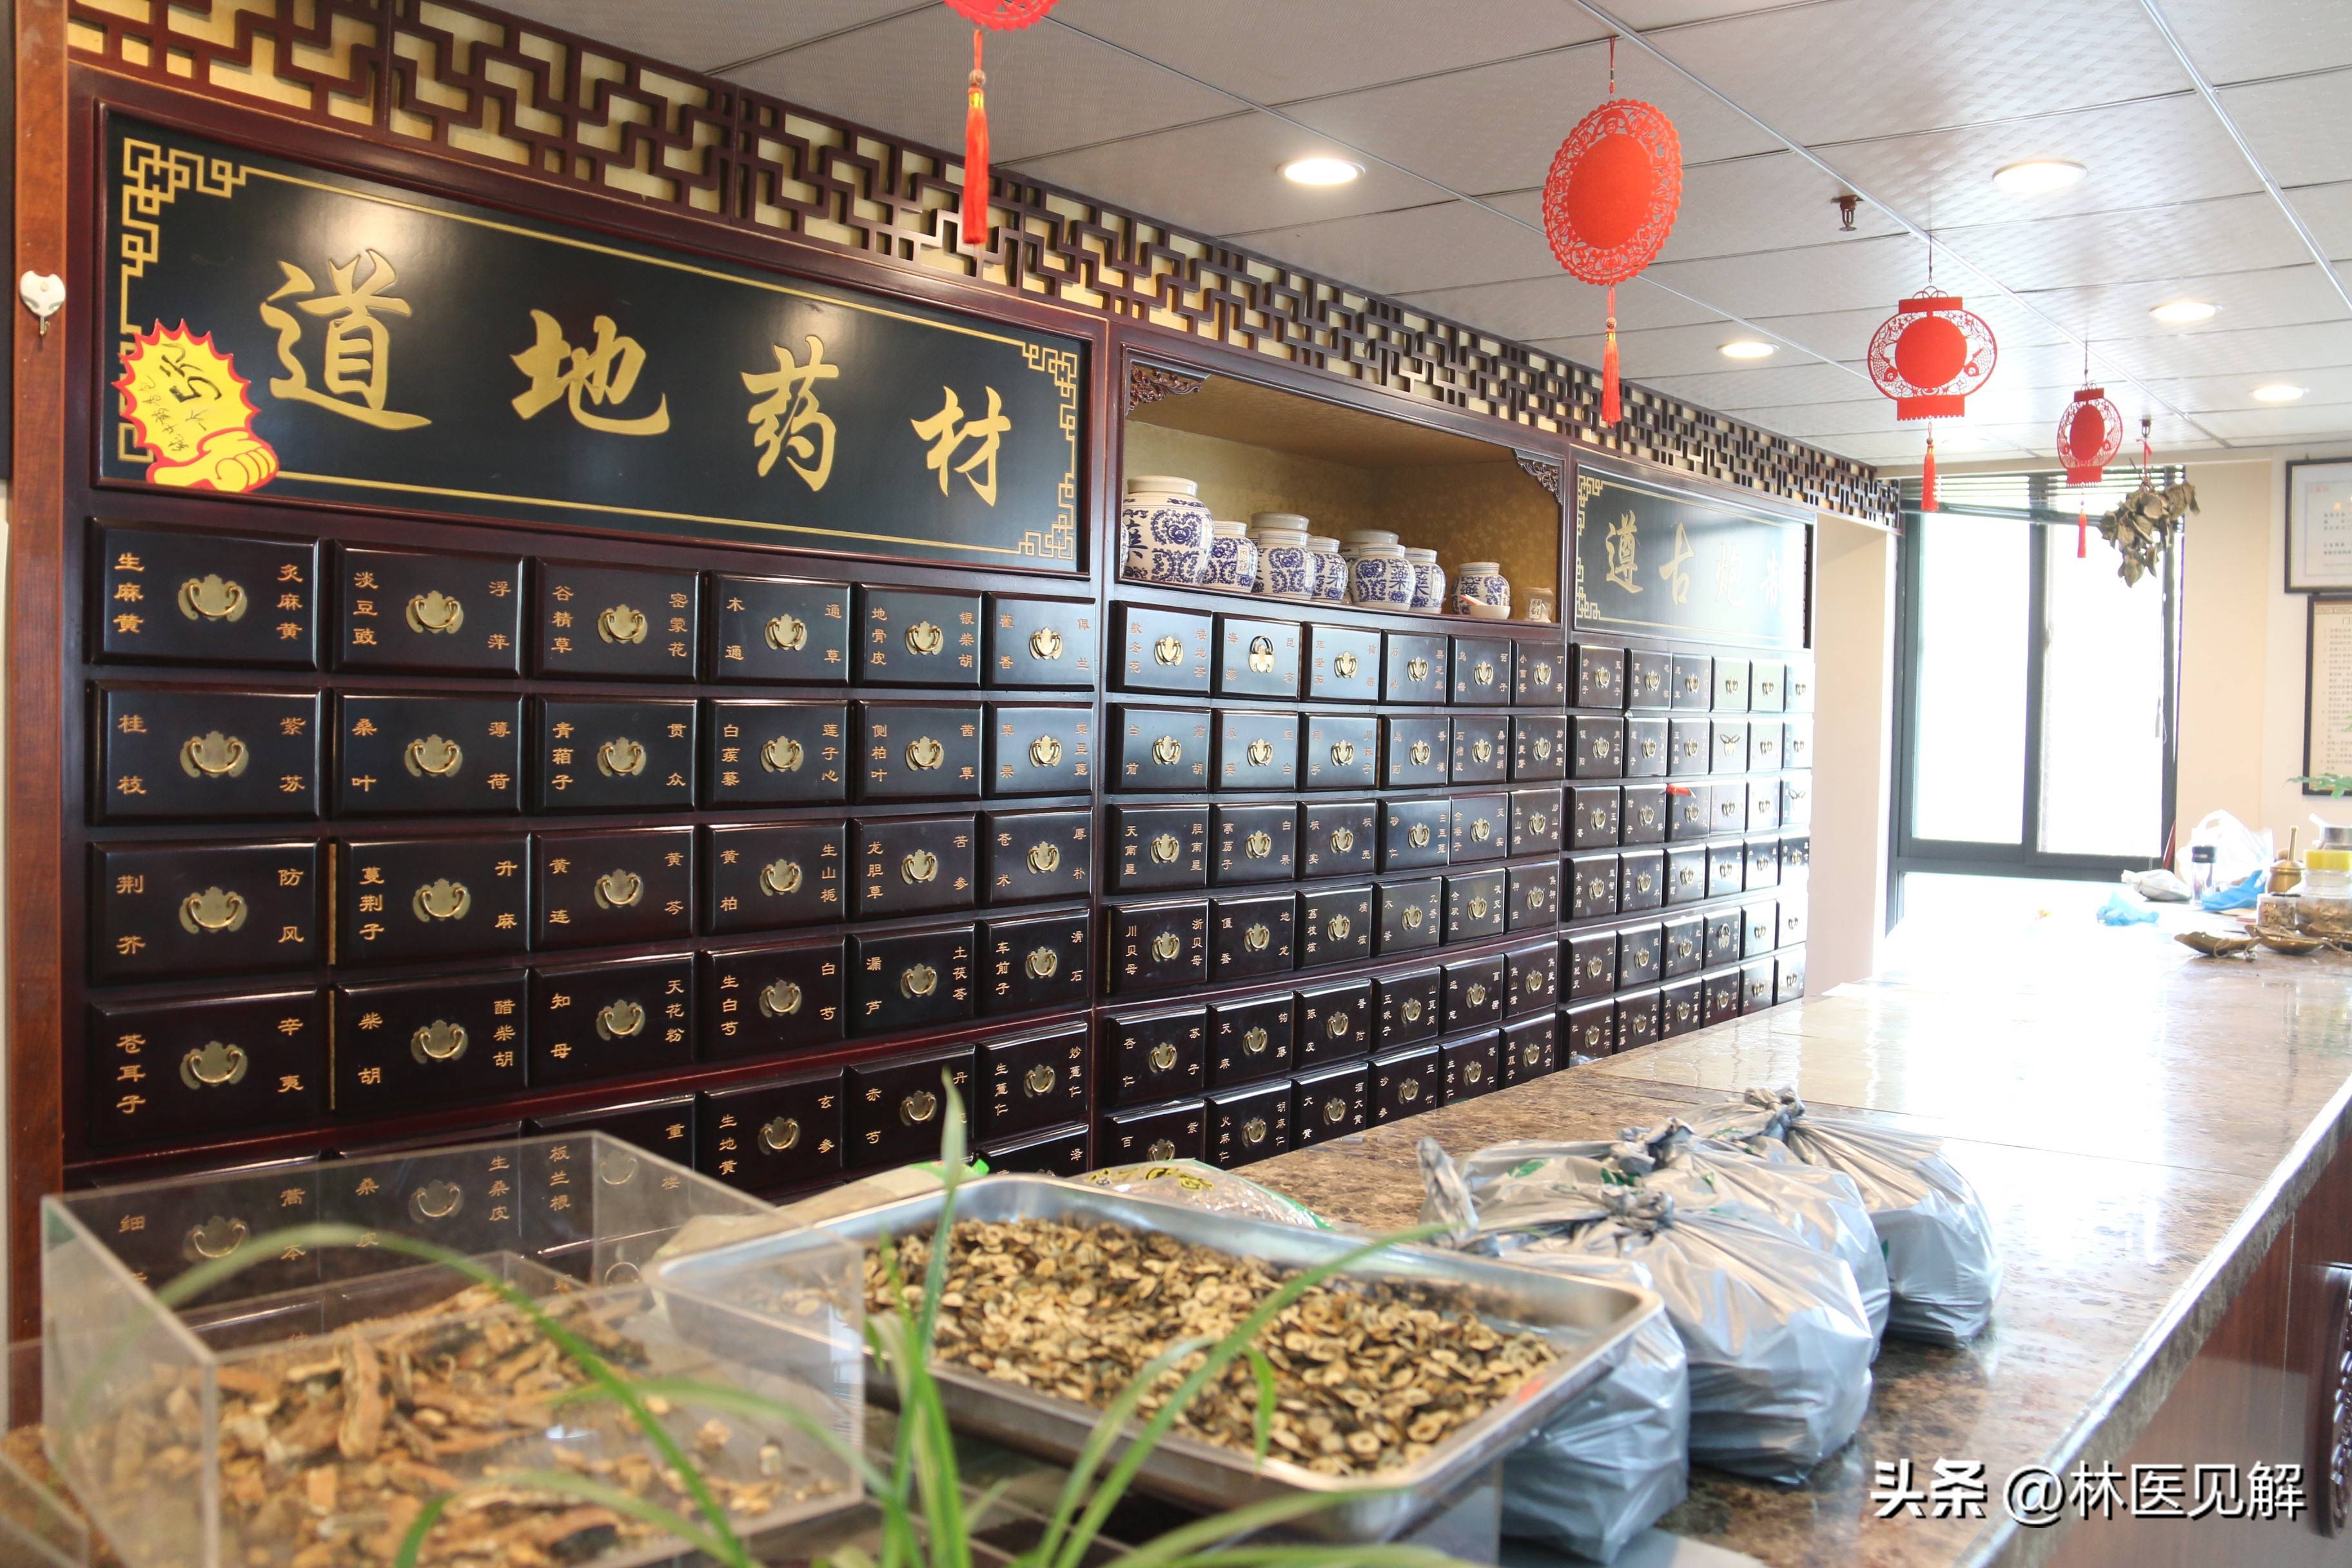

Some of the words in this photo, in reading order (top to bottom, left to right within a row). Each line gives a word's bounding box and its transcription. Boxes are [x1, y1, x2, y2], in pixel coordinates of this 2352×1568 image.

[258, 248, 1012, 507] 道地药材
[113, 553, 144, 633] 生麻黄
[276, 564, 304, 640] 炙麻黄
[352, 572, 378, 645] 淡豆豉
[487, 581, 511, 650] 浮萍
[551, 585, 574, 653] 谷精草
[668, 593, 689, 658] 密蒙花
[725, 598, 745, 661] 木通
[824, 603, 842, 663] 通草
[870, 608, 888, 665] 地骨皮
[959, 612, 975, 667] 银柴胡
[999, 614, 1014, 669] 藿香
[1077, 618, 1090, 671] 佩兰
[1556, 656, 1564, 692] 丁香
[117, 714, 147, 795] 桂枝
[279, 717, 306, 793] 紫苏
[351, 718, 378, 792] 桑叶
[487, 721, 511, 790] 薄荷
[551, 721, 574, 790] 青葙子
[666, 723, 687, 787] 贯众
[721, 723, 740, 787] 白蒺藜
[821, 723, 839, 782] 莲子心
[870, 724, 888, 782] 侧柏叶
[959, 724, 975, 779] 茜草
[1000, 723, 1014, 778] 草果
[1074, 723, 1088, 776] 草豆蔻
[1126, 725, 1141, 775] 白前
[867, 841, 884, 899] 龙胆草
[954, 835, 968, 890] 苦参
[996, 833, 1012, 887] 苍术
[1073, 828, 1086, 880] 厚朴
[1124, 825, 1138, 876] 天南星
[1190, 823, 1203, 871] 胆南星
[1221, 823, 1234, 870] 葶苈子
[1280, 820, 1291, 865] 白果
[495, 860, 518, 929] 升麻
[549, 858, 571, 924] 黄连
[664, 852, 683, 915] 黄芩
[720, 849, 740, 912] 黄柏
[820, 844, 838, 903] 生山栀
[116, 875, 146, 955] 荆芥
[278, 868, 304, 943] 防风
[359, 867, 385, 941] 蔓荆子
[1070, 930, 1084, 981] 滑石
[1124, 925, 1138, 975] 川贝母
[1191, 918, 1204, 966] 浙贝母
[1220, 917, 1233, 965] 僵蚕
[1279, 912, 1291, 956] 地龙
[819, 963, 836, 1021] 白芍
[866, 956, 882, 1015] 漏芦
[952, 946, 968, 1001] 土茯苓
[995, 941, 1010, 995] 车前子
[493, 999, 516, 1068] 醋柴胡
[550, 993, 572, 1059] 知母
[665, 979, 685, 1043] 天花粉
[720, 975, 739, 1036] 生白芍
[1276, 1013, 1288, 1057] 钩藤
[116, 1034, 146, 1115] 苍耳子
[278, 1017, 304, 1093] 辛夷
[357, 1012, 383, 1085] 柴胡
[1122, 1037, 1136, 1088] 杏仁
[1188, 1028, 1200, 1075] 苏子
[1219, 1023, 1232, 1070] 天麻
[718, 1114, 737, 1175] 生地黄
[818, 1095, 834, 1153] 玄参
[865, 1088, 882, 1144] 赤芍
[1219, 1116, 1231, 1162] 火麻仁
[549, 1145, 571, 1211] 板兰根
[662, 1124, 685, 1191] 重楼
[488, 1156, 509, 1222] 生桑皮
